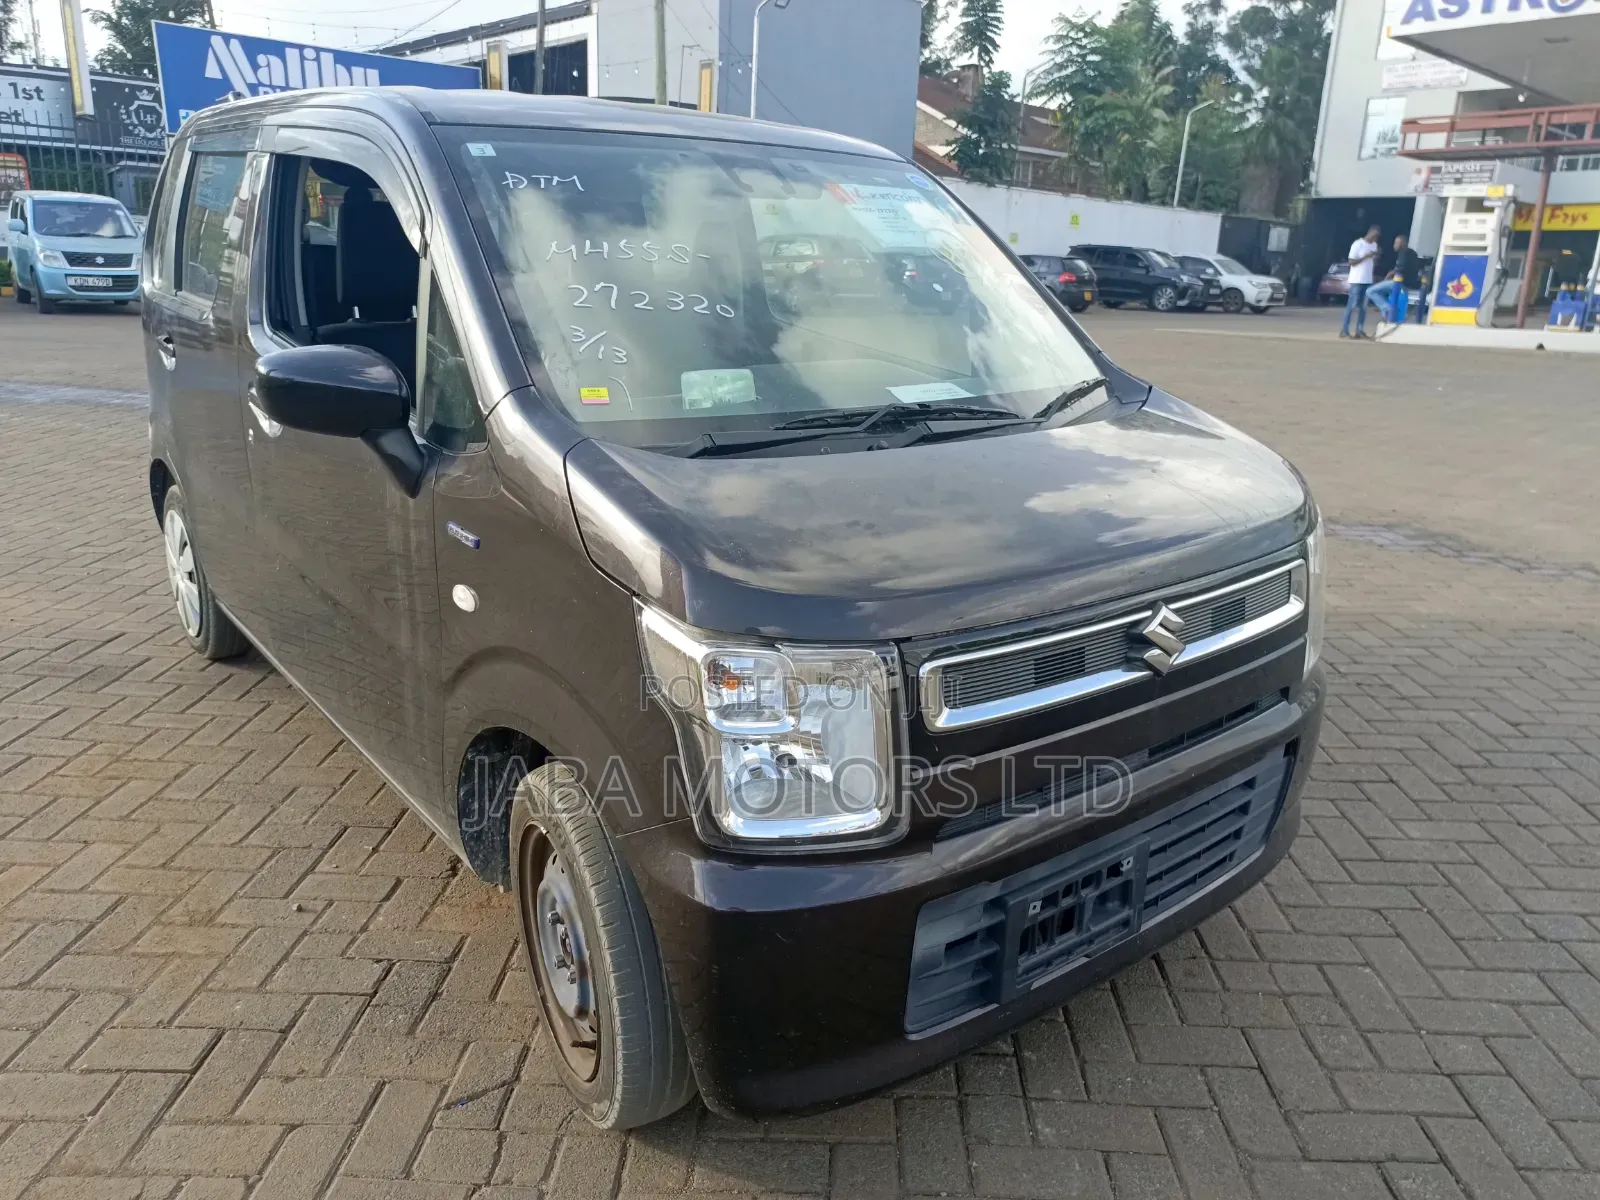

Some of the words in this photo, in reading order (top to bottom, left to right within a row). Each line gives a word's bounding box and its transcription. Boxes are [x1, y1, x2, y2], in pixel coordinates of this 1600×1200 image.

[204, 35, 380, 97] Malibu
[8, 82, 45, 101] 1st
[567, 281, 735, 318] 272320
